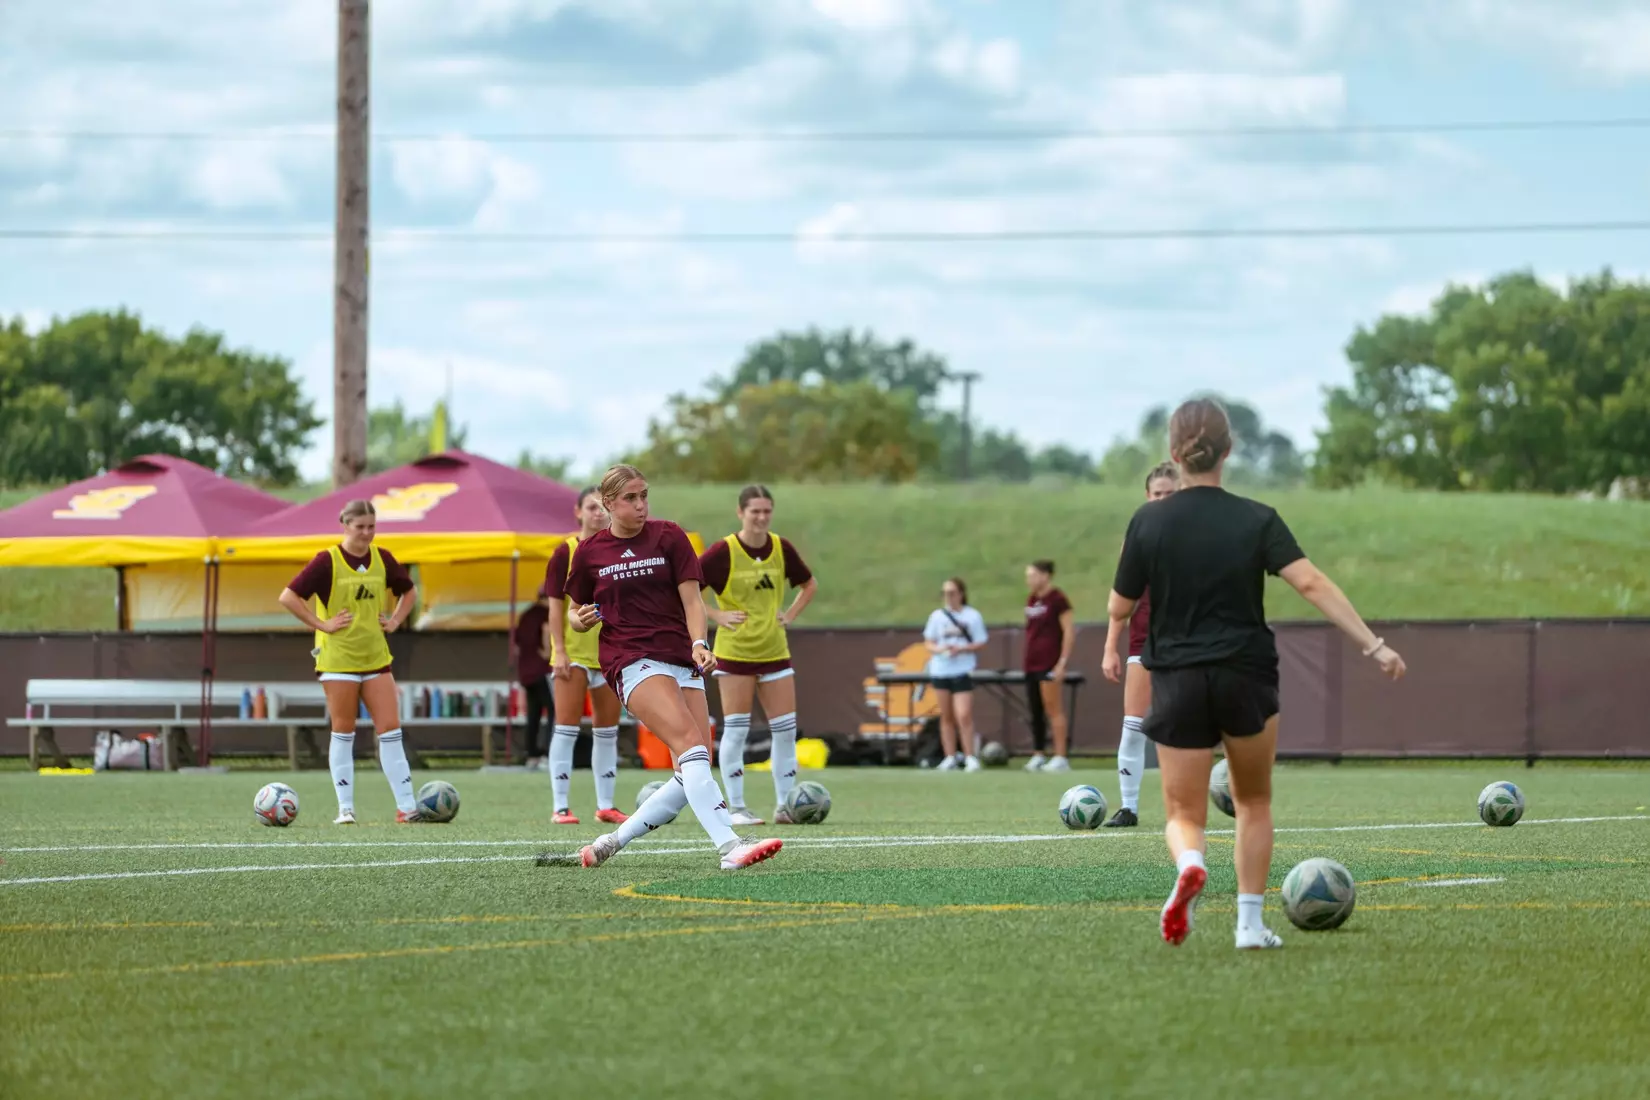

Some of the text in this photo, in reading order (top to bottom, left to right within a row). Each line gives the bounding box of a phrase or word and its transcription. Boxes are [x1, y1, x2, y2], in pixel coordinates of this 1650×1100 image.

[599, 557, 665, 577] CENTRAL MICHIGAN
[613, 568, 654, 581] SOCCER
